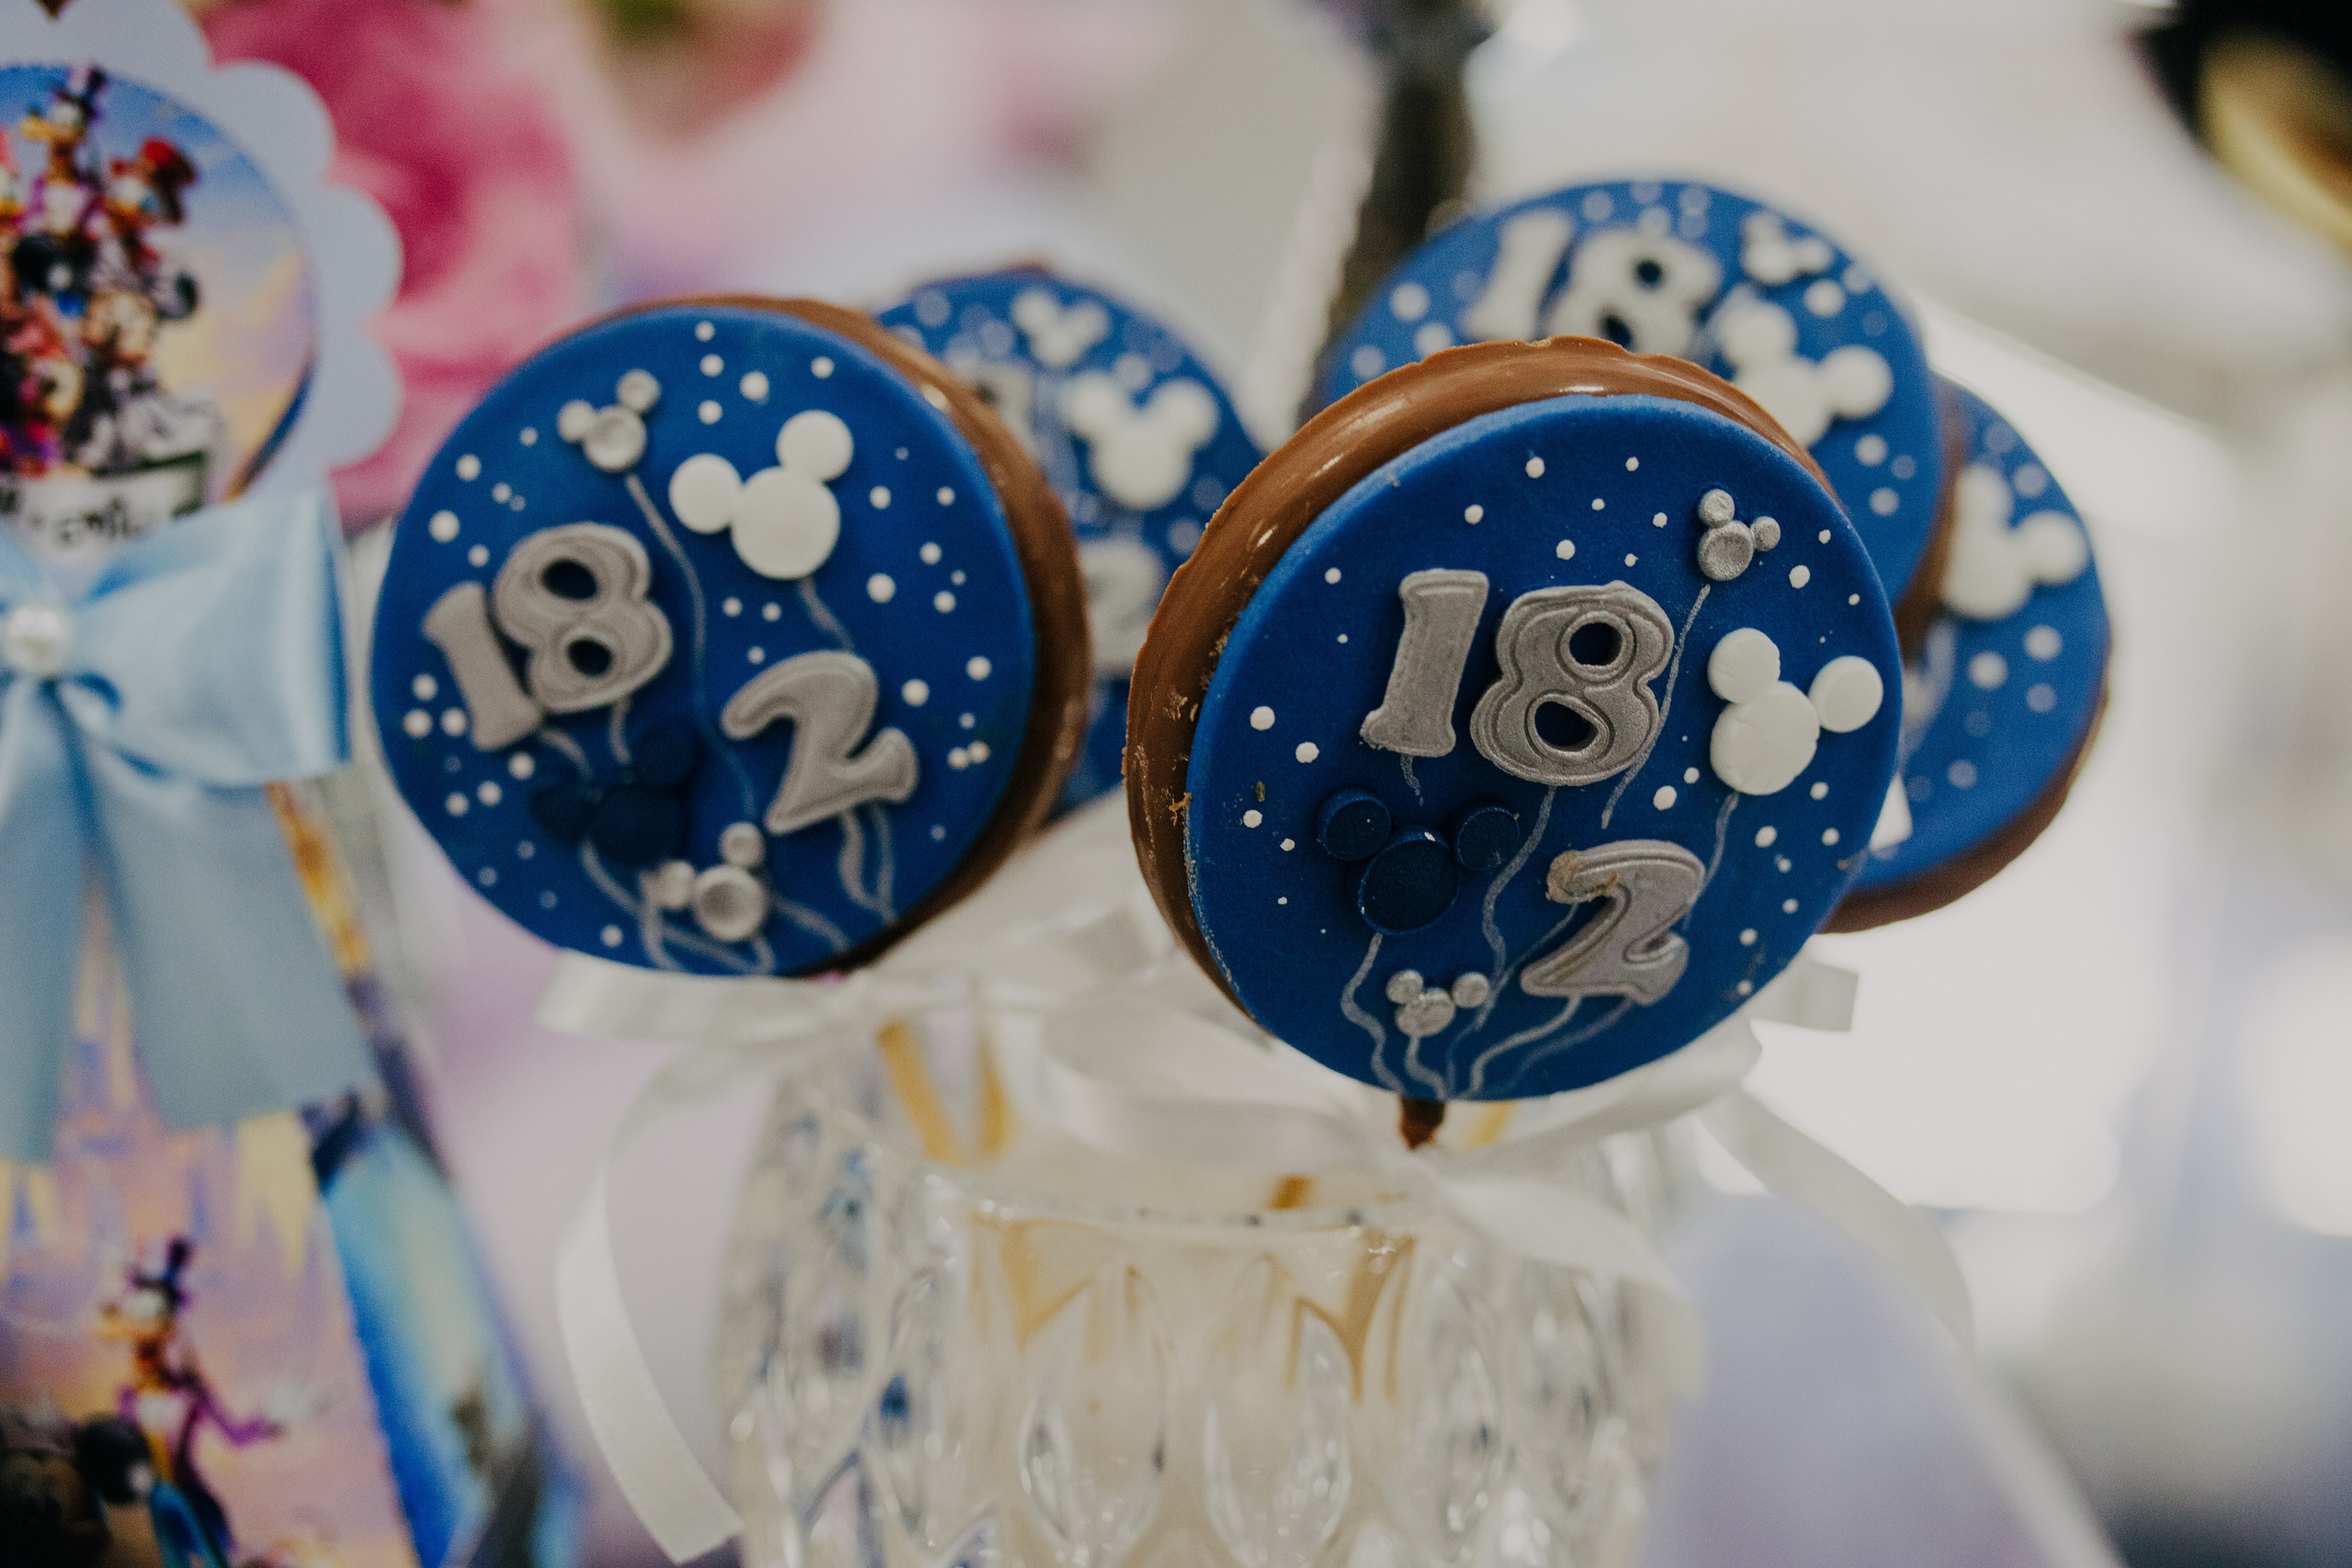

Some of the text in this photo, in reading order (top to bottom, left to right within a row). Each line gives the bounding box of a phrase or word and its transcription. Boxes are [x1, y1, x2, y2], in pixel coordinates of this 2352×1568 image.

[1464, 207, 1722, 356] 18
[421, 521, 673, 751] 18
[1360, 568, 1675, 786] 18
[721, 650, 920, 834] 2
[1521, 840, 1705, 1006] 2
